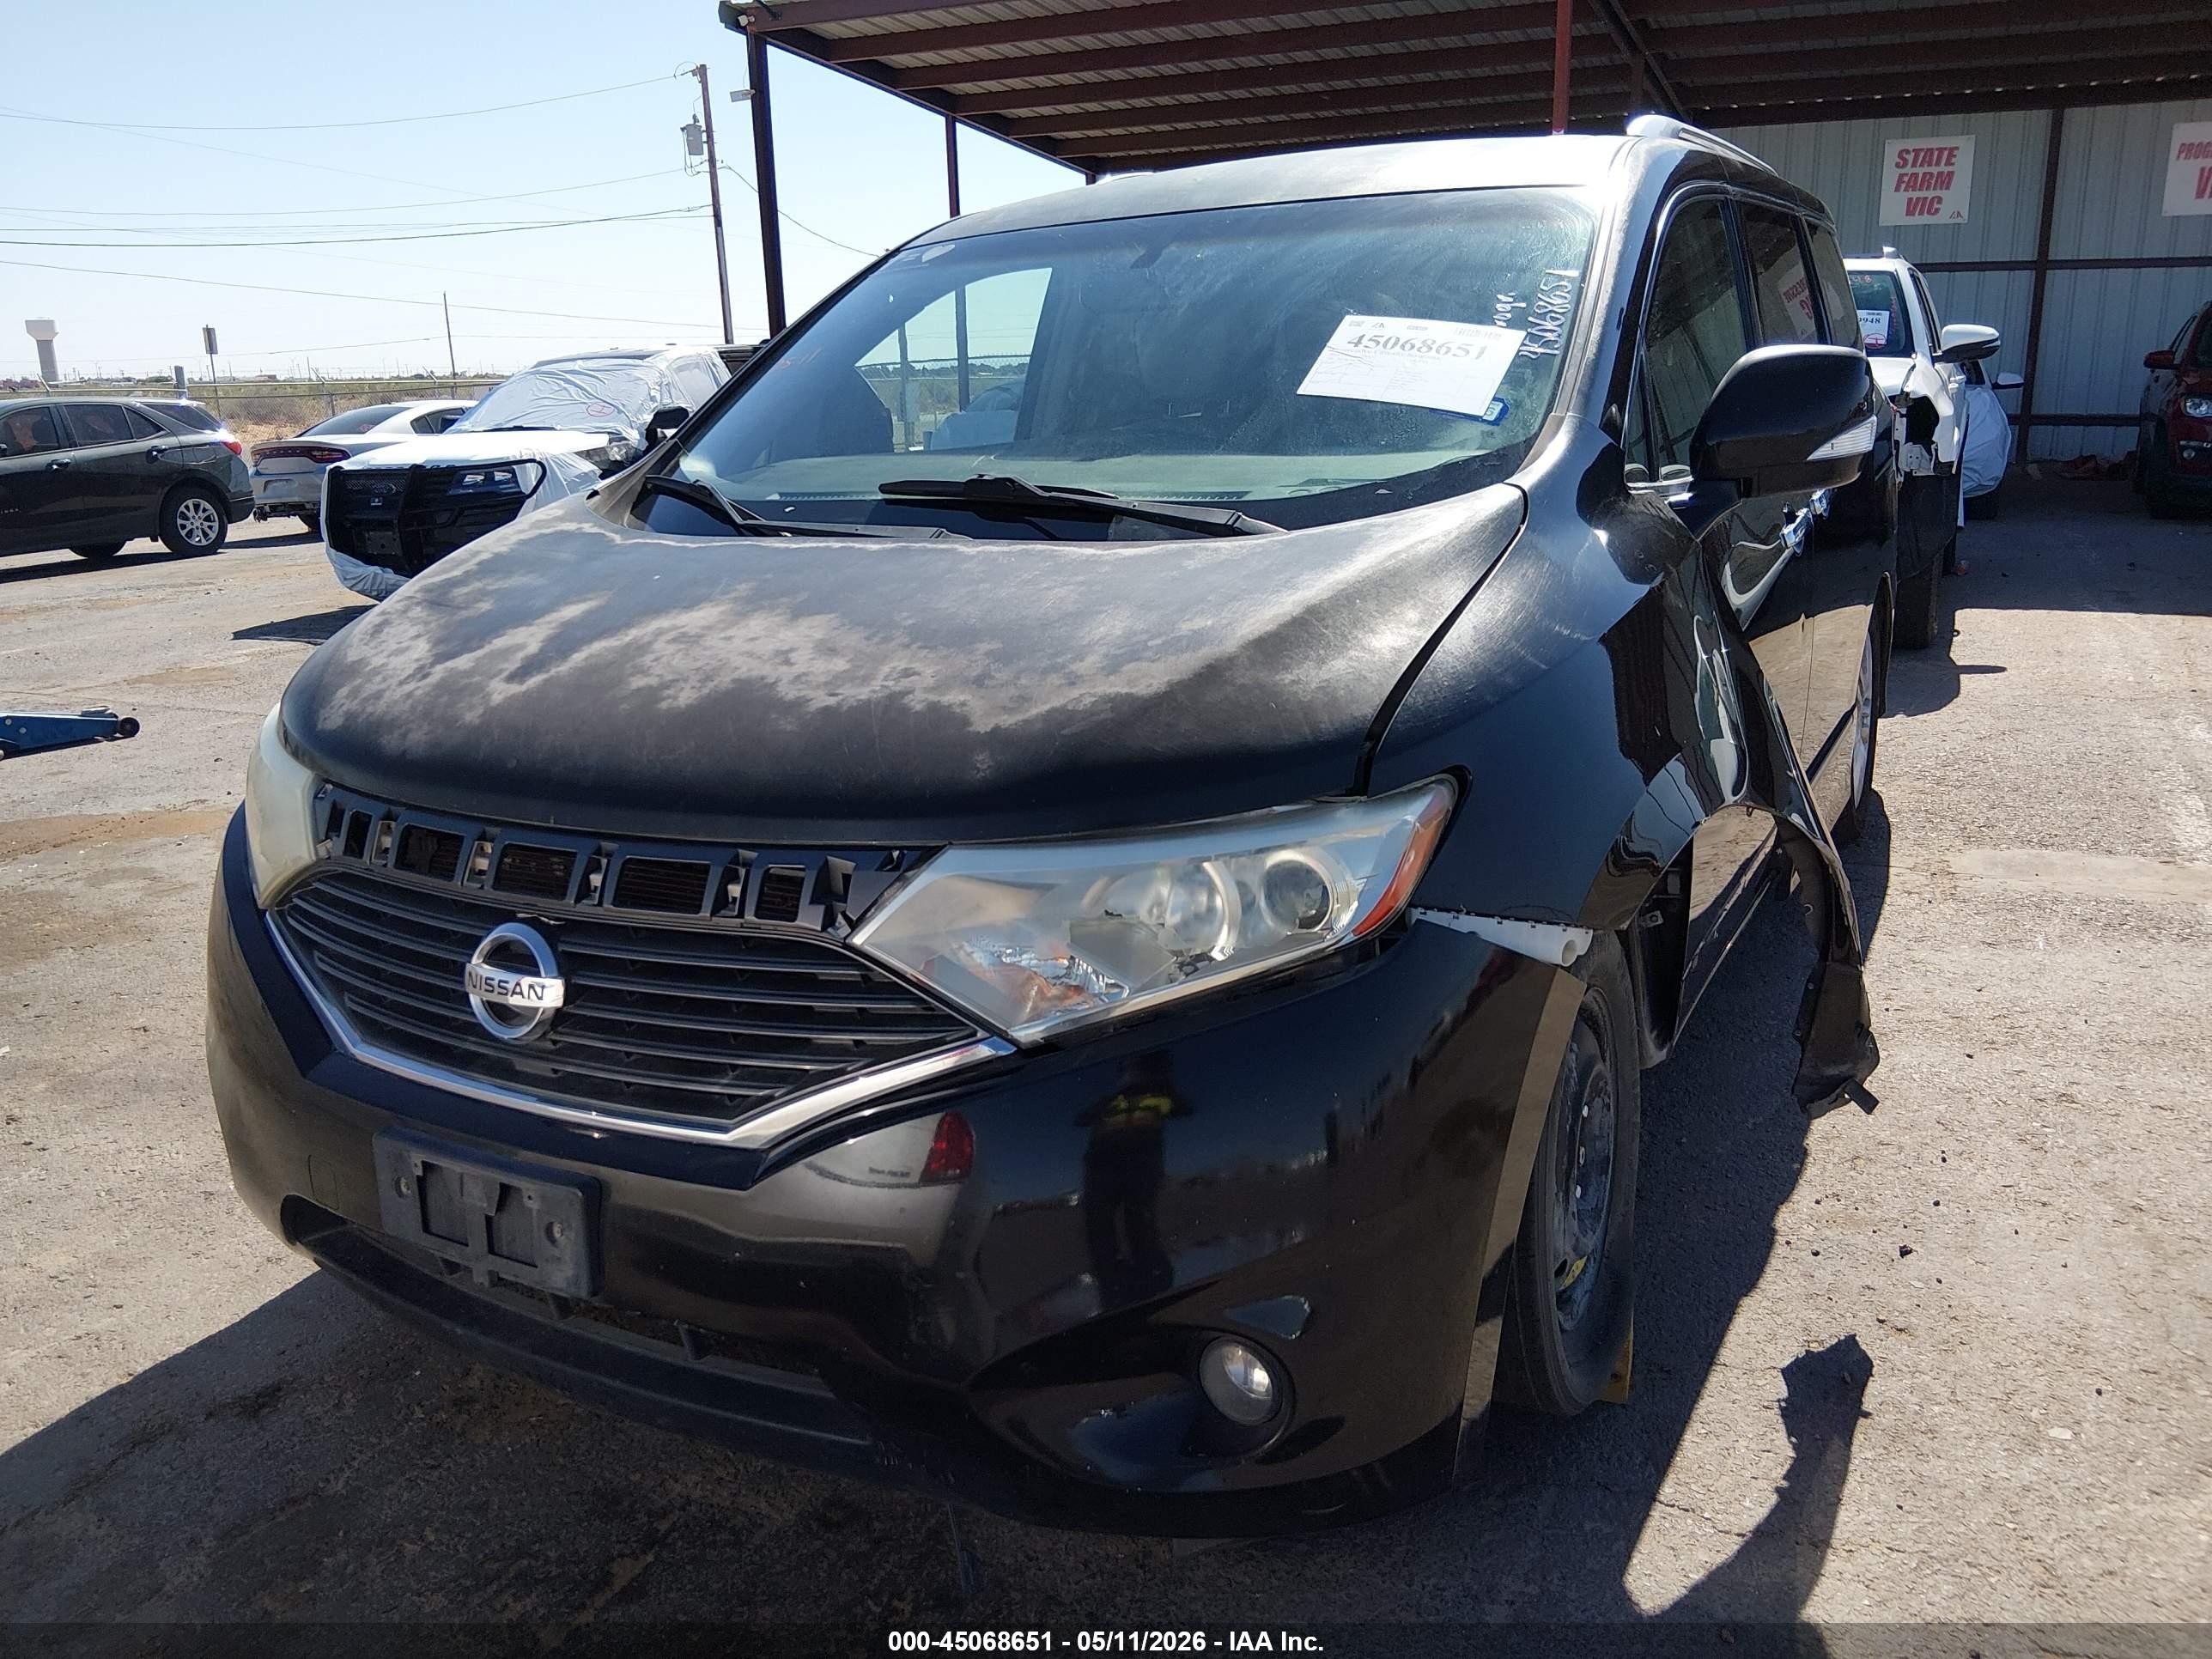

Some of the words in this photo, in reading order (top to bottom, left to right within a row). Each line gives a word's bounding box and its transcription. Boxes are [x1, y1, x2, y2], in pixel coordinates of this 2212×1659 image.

[1894, 146, 1960, 169] STATE
[1894, 171, 1955, 192] FARM
[1905, 195, 1943, 216] VIC
[1518, 269, 1580, 359] 45068651
[1346, 333, 1488, 361] 45068651
[468, 970, 545, 1000] NISSAN
